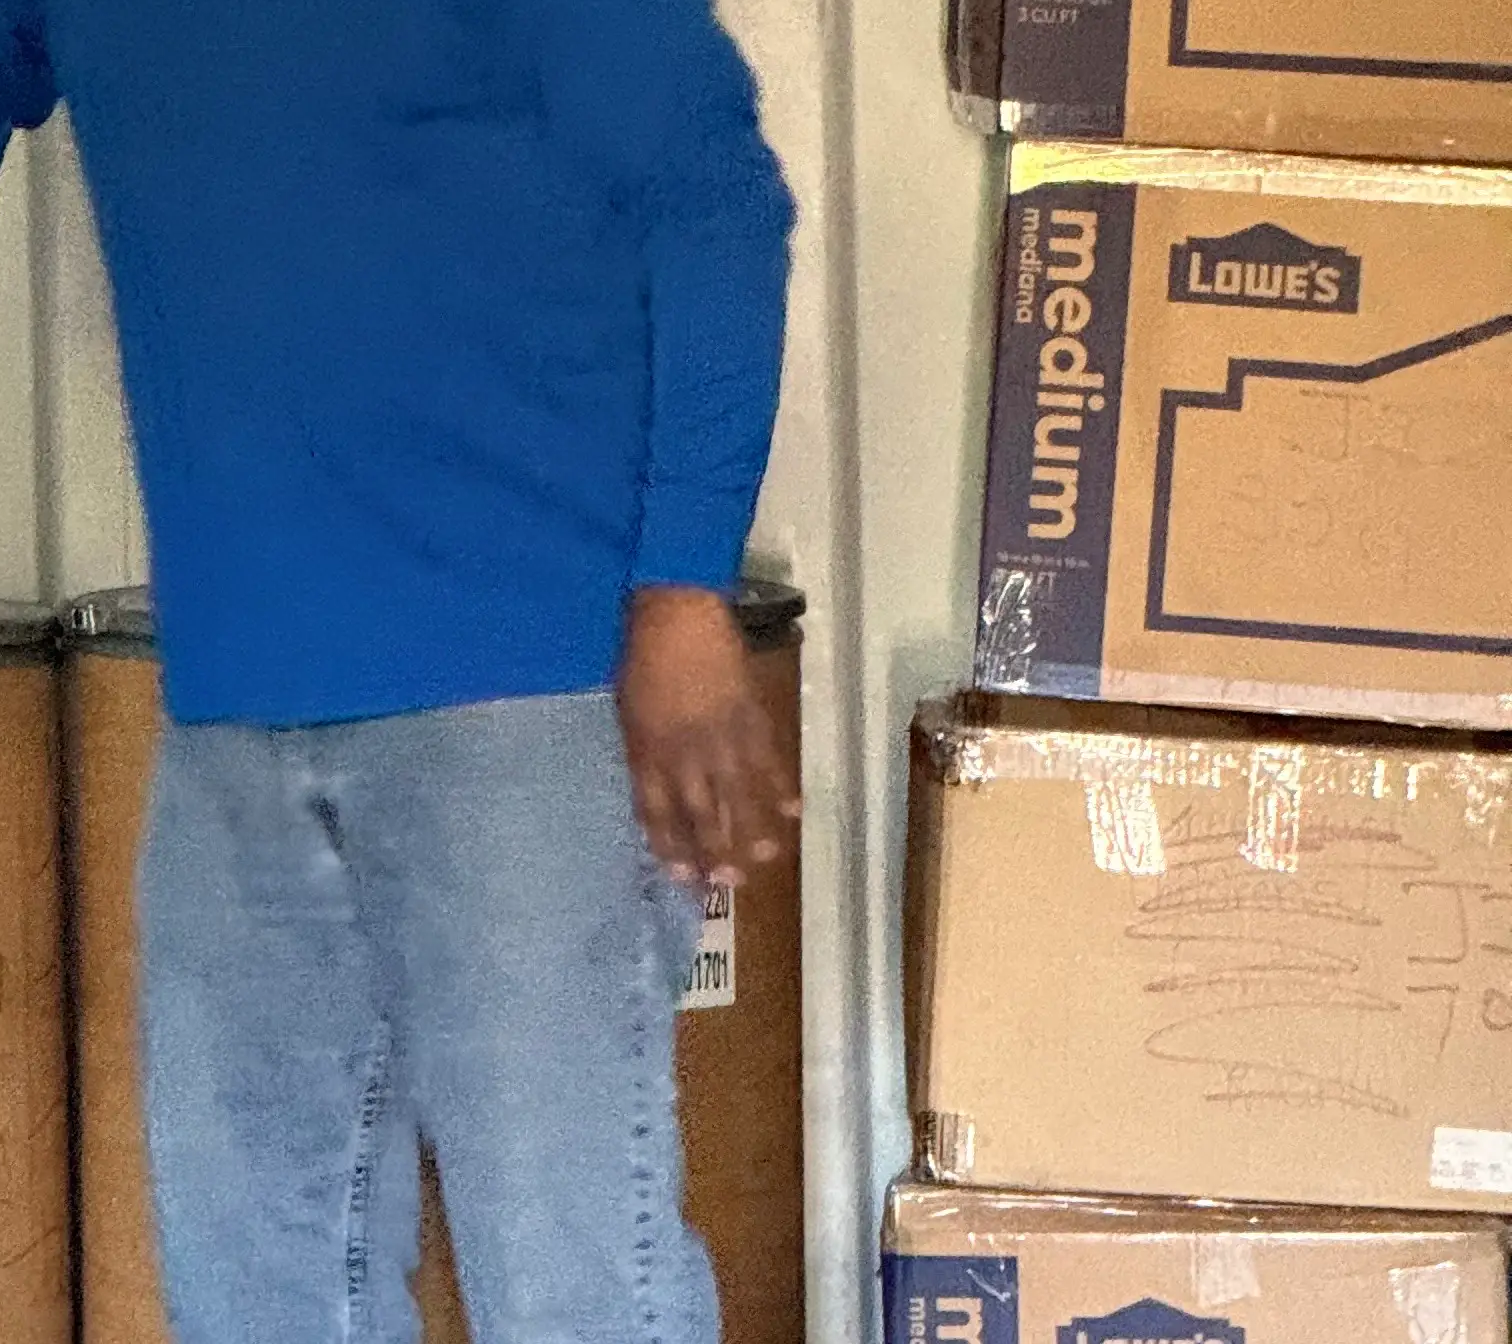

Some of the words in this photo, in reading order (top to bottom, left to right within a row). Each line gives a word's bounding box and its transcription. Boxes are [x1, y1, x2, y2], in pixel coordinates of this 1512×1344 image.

[1013, 208, 1041, 323] mediana
[1187, 251, 1342, 304] LOWE'S
[1027, 209, 1105, 539] medium
